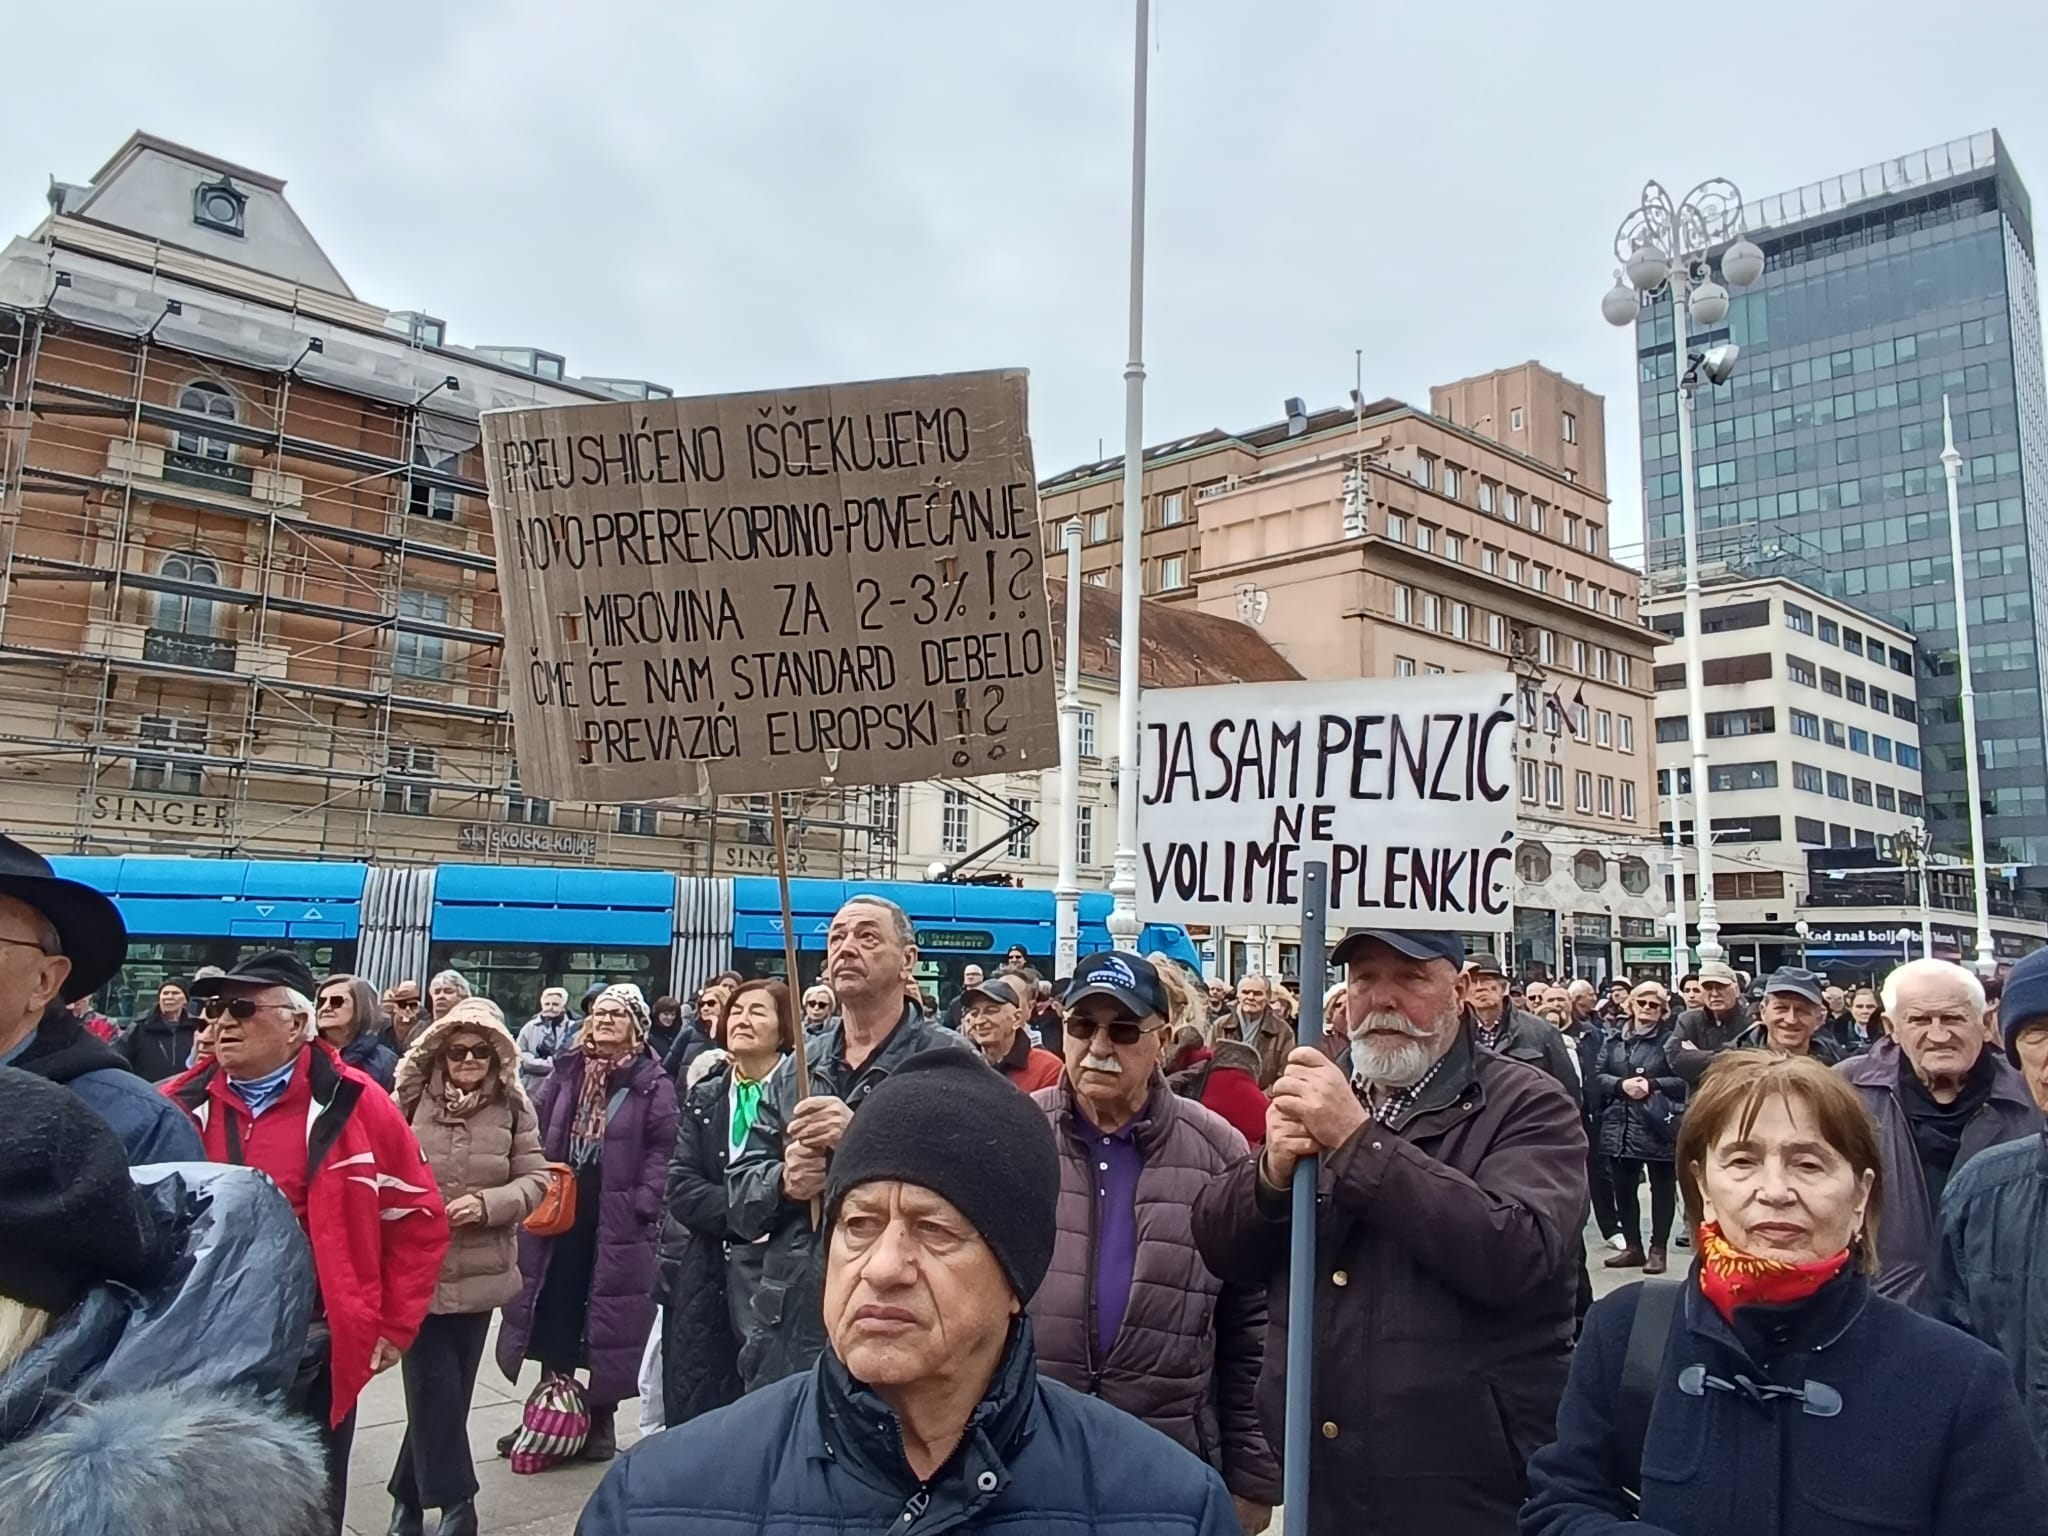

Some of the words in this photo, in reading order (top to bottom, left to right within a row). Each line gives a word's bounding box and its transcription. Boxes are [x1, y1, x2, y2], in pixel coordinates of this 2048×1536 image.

[503, 417, 725, 494] PREUSHIĆENO
[746, 406, 970, 480] IŠČEKUJEMO
[584, 587, 745, 647] MIROVINA
[773, 581, 830, 636] ZA
[589, 648, 627, 707] ĆE
[644, 655, 715, 703] NAM
[731, 645, 897, 702] STANDARD
[922, 628, 1045, 687] DEBELO
[579, 701, 741, 765] PREVAZIĆI
[766, 699, 939, 756] EUROPSKI
[1204, 718, 1302, 802] SAM
[1315, 693, 1515, 802] PENZIĆ
[92, 796, 230, 829] SINGER
[1274, 803, 1336, 843] NE
[1331, 831, 1513, 915] PLENKIĆ
[1834, 929, 1865, 942] znaš
